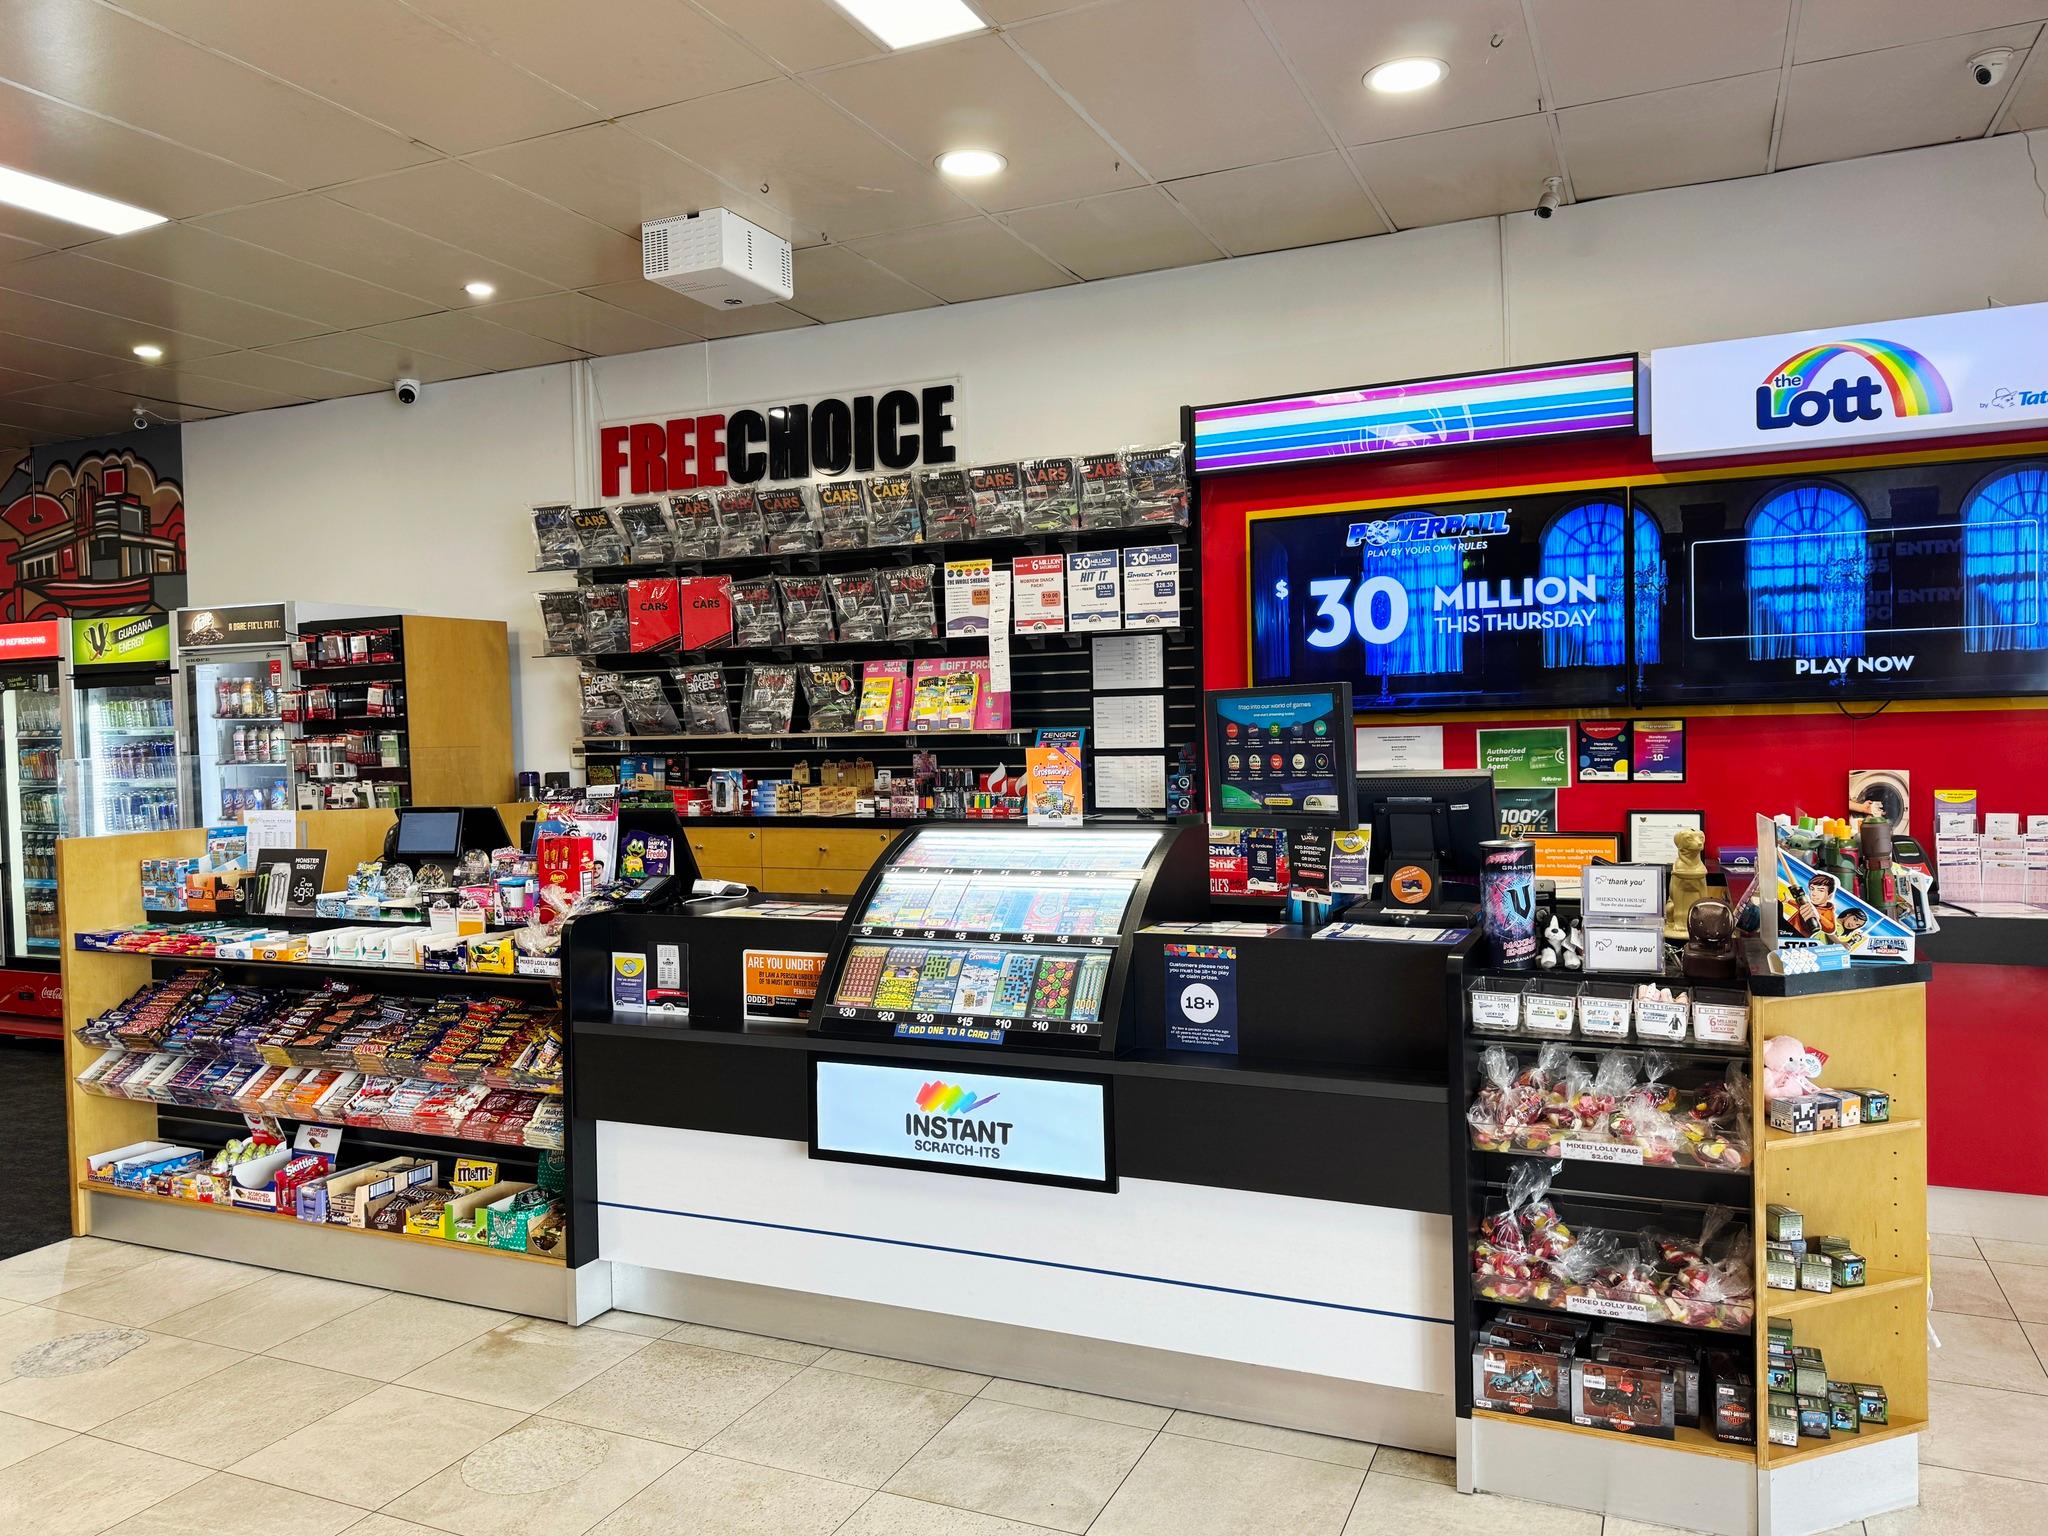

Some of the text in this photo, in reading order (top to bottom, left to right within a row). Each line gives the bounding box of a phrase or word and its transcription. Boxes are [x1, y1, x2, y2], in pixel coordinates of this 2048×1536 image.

[1774, 374, 1801, 388] the
[1756, 375, 1882, 430] Lott
[975, 473, 1015, 488] CARS
[823, 489, 859, 504] CARS
[873, 483, 909, 498] CARS
[676, 501, 709, 516] CARS
[764, 497, 799, 510] CARS
[576, 515, 608, 528] CARS
[1346, 511, 1510, 547] POWERBALL
[1368, 541, 1488, 558] PLAY BY YOUR OWN RULES
[1080, 571, 1108, 582] HIT IT
[640, 602, 668, 611] CARS
[692, 600, 721, 609] CARS
[1307, 575, 1409, 648] 30
[1433, 574, 1597, 611] MILLION
[1435, 608, 1597, 634] THIS THURSDAY
[118, 619, 153, 640] GUARANA
[118, 638, 146, 653] ENERGY
[946, 660, 968, 670] GIFT
[1795, 656, 1915, 675] PLAY NOW
[585, 683, 615, 695] BIKES
[687, 681, 717, 692] BIKES
[1487, 747, 1526, 755] Authorised
[1487, 755, 1523, 763] GreenCard
[1652, 754, 1664, 762] 10
[1501, 809, 1548, 824] 100%
[646, 849, 667, 860] Freddo
[861, 926, 873, 935] $5
[892, 928, 904, 937] $5
[923, 929, 935, 938] $5
[955, 930, 967, 940] $5
[989, 932, 1001, 941] $5
[1022, 933, 1034, 943] $5
[1056, 934, 1069, 944] $5
[1091, 935, 1104, 945] $5
[748, 956, 814, 971] ARE YOU UNDER
[747, 995, 767, 1003] ODDS
[1185, 997, 1214, 1009] 18+
[839, 1007, 857, 1019] $30
[877, 1010, 895, 1021] $20
[916, 1012, 934, 1024] $20
[957, 1016, 974, 1027] $15
[995, 1017, 1012, 1029] $10
[1032, 1020, 1049, 1032] $10
[908, 1026, 989, 1040] ADD ONE TO A CARD
[1070, 1022, 1088, 1034] $10
[906, 1113, 1013, 1146] INSTANT
[914, 1139, 1000, 1159] SCRATCH-ITS
[1566, 1142, 1639, 1155] MIXED LOLLY BAG
[1591, 1153, 1614, 1161] $2.00
[285, 1156, 319, 1177] Skittles
[116, 1178, 141, 1188] mentos
[1572, 1297, 1645, 1311] MIXED LOLLY BAG
